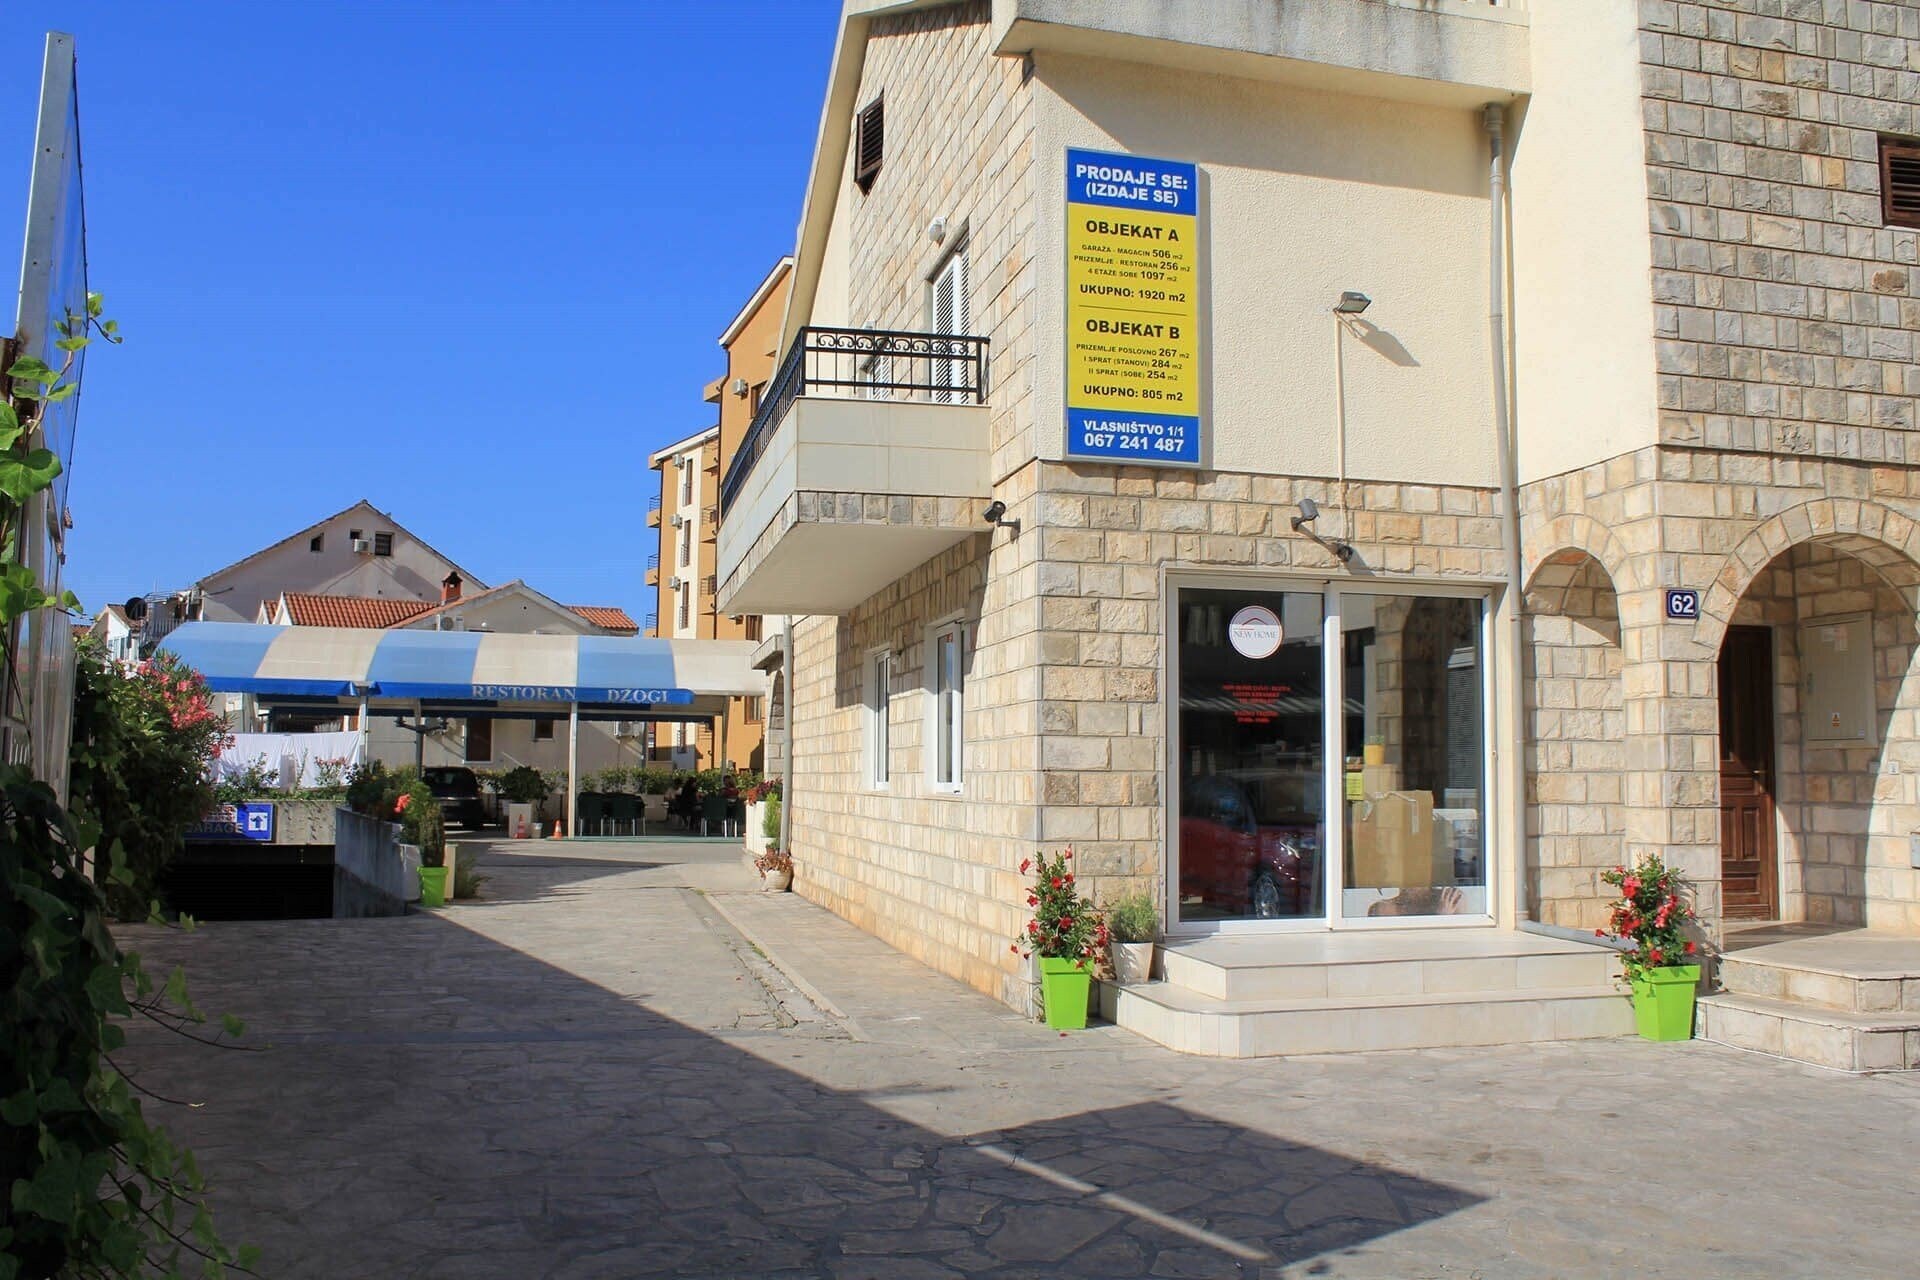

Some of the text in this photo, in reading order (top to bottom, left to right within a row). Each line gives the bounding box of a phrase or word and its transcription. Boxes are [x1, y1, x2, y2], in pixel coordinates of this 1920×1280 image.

[1076, 164, 1188, 189] PRODAJE SE:
[1086, 182, 1179, 207] (IZDAJE SE)
[1086, 220, 1179, 241] OBJEKAT A
[1117, 248, 1150, 256] MAGACIN
[1152, 250, 1171, 259] 506
[1074, 255, 1114, 264] PRIZEMLJE
[1120, 259, 1158, 269] RESTORAN
[1160, 262, 1178, 271] 256
[1141, 271, 1165, 280] 1097
[1080, 284, 1186, 302] UKUPNO: 1920 m2
[1086, 320, 1180, 339] OBJEKAT B
[1076, 344, 1116, 352] PRIZEMLJE
[1118, 347, 1157, 356] POSLOVNO
[1159, 348, 1177, 357] 267
[1113, 359, 1150, 367] (STANOVI)
[1151, 360, 1170, 368] 284
[1147, 371, 1166, 379] 254
[1083, 385, 1183, 401] UKUPNO: 805 m2
[1083, 420, 1184, 437] VLASNIŠTVO 1/1
[1084, 433, 1184, 452] 067 241 487
[1671, 594, 1695, 614] 62
[472, 685, 576, 700] RESTORAN
